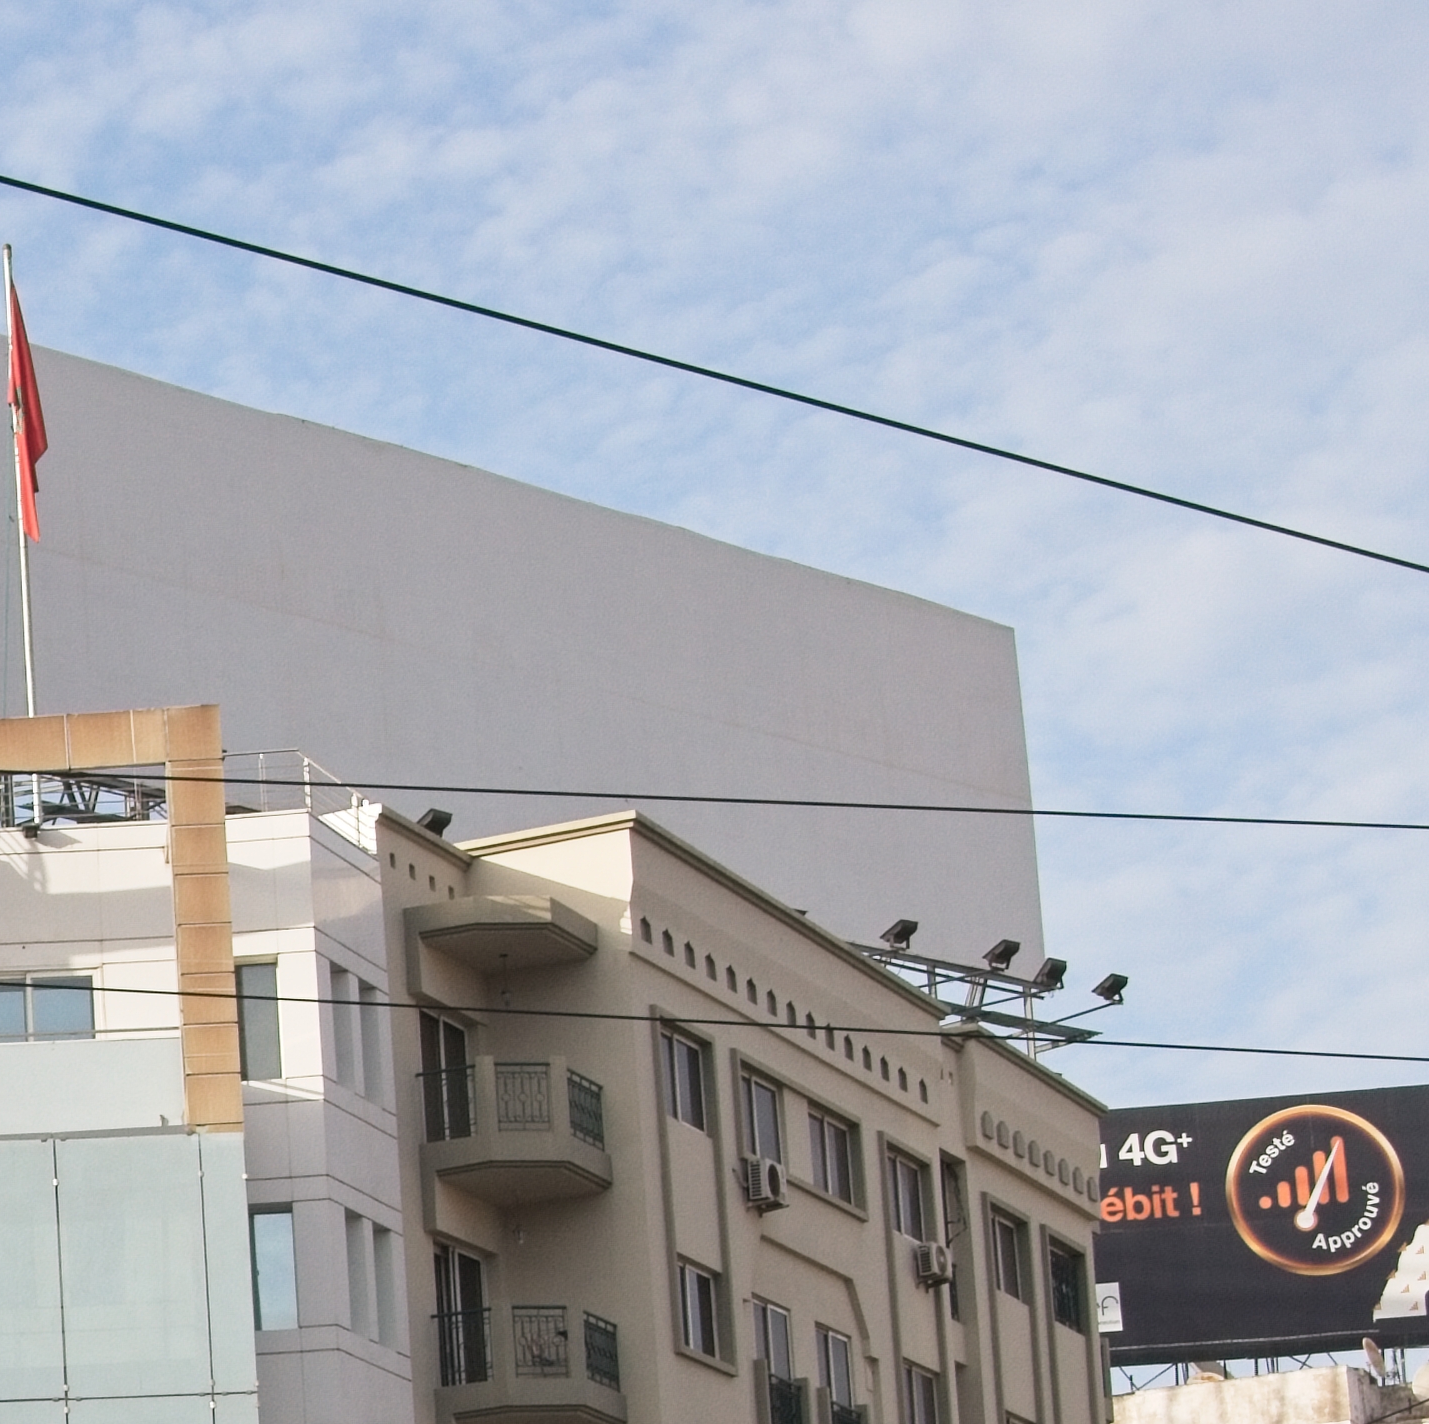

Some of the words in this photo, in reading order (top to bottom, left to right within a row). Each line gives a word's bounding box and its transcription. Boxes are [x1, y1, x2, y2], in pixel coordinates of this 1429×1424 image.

[1118, 1129, 1193, 1167] 4G+
[1249, 1129, 1296, 1177] Testé
[1099, 1183, 1179, 1222] ébit
[1312, 1181, 1380, 1253] Approuvé
